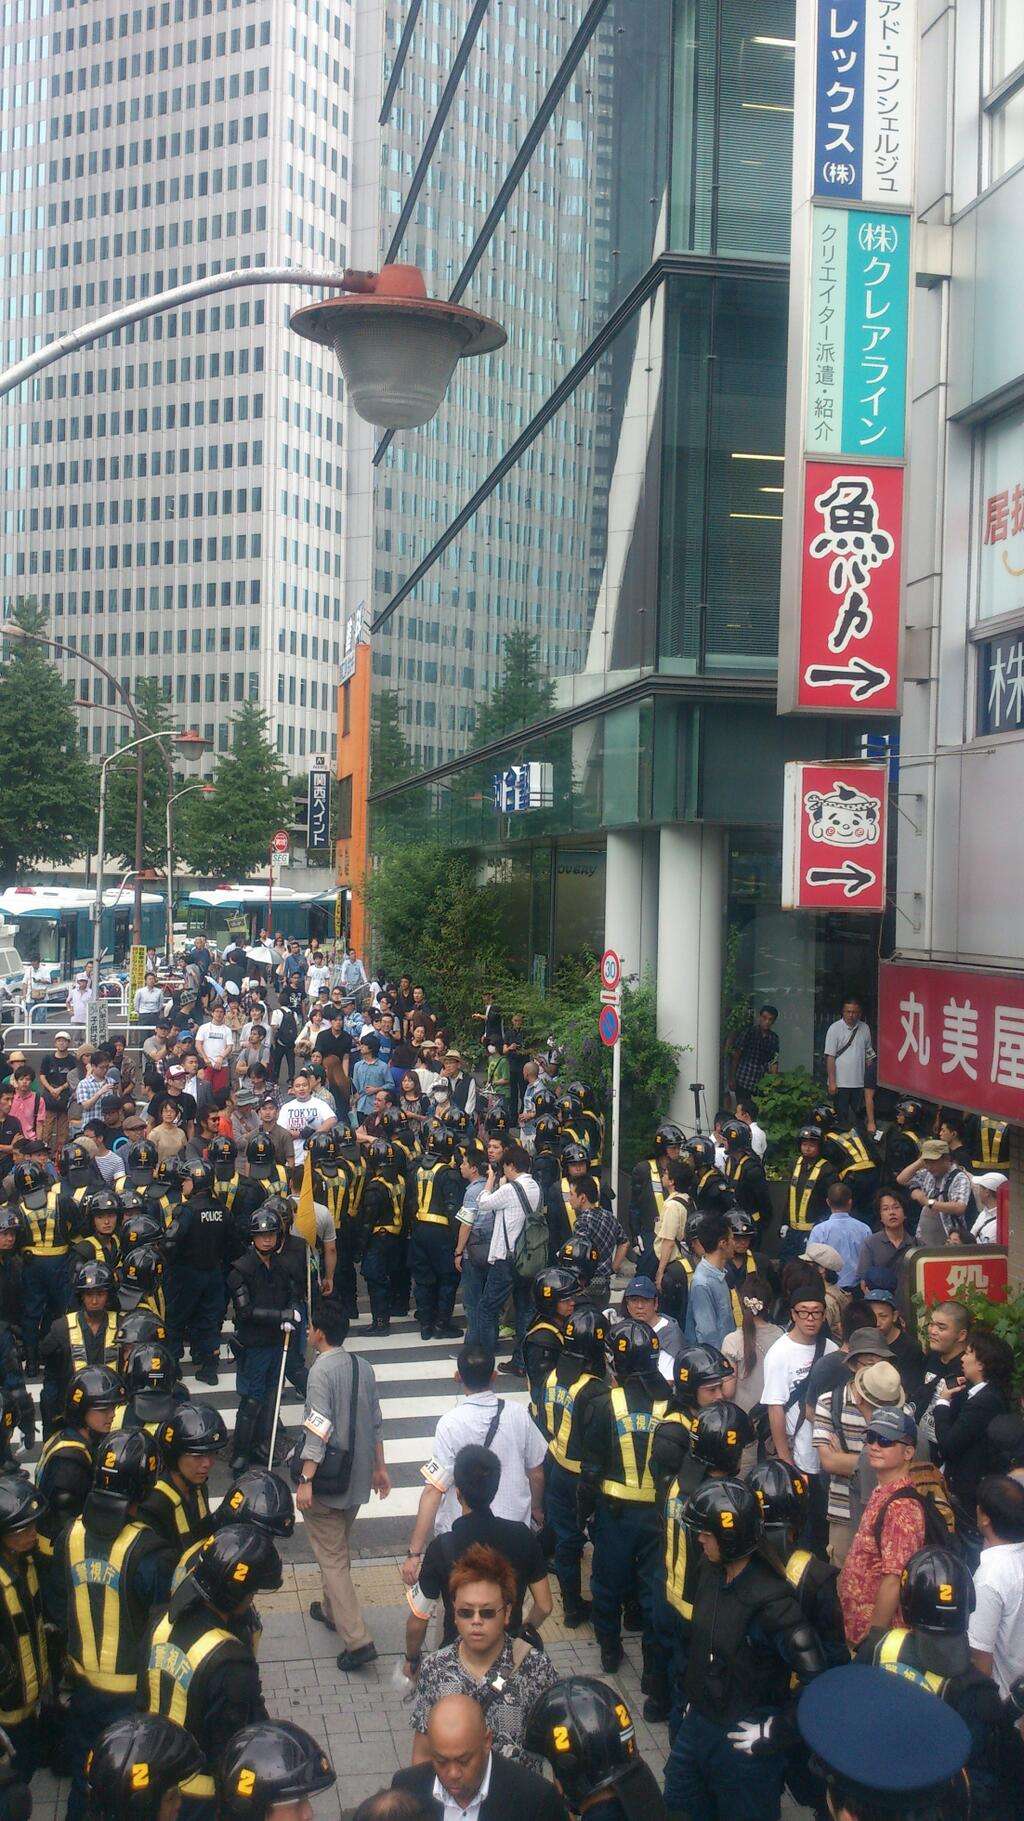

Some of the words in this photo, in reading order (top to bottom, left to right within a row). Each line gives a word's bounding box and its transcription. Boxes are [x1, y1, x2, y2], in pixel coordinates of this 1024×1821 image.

[814, 224, 837, 441] クリエイター派遣・紹介
[858, 223, 898, 446] (株)クレアライン
[313, 773, 326, 846] 関西ペイント
[606, 961, 616, 978] 30
[897, 991, 1024, 1089] 丸美屋
[287, 1107, 318, 1118] TOKYO
[200, 1210, 223, 1223] POLICE
[129, 1231, 138, 1242] 2
[563, 1244, 573, 1256] 2
[543, 1286, 551, 1297] 2
[566, 1323, 574, 1336] 2
[596, 1328, 604, 1340] 2
[618, 1339, 627, 1352] 2
[151, 1357, 161, 1370] 2
[680, 1368, 689, 1382] 2
[72, 1388, 83, 1403] 2
[165, 1427, 174, 1443] 2
[727, 1430, 737, 1445] 2
[105, 1451, 116, 1468] 2
[794, 1479, 803, 1494] 2
[230, 1493, 244, 1510] 2
[720, 1511, 734, 1529] 2
[233, 1563, 249, 1582] 2
[939, 1583, 953, 1602] 2
[614, 1704, 631, 1728] 2
[552, 1725, 571, 1752] 2
[131, 1762, 150, 1790] 2
[236, 1769, 257, 1797] 2
